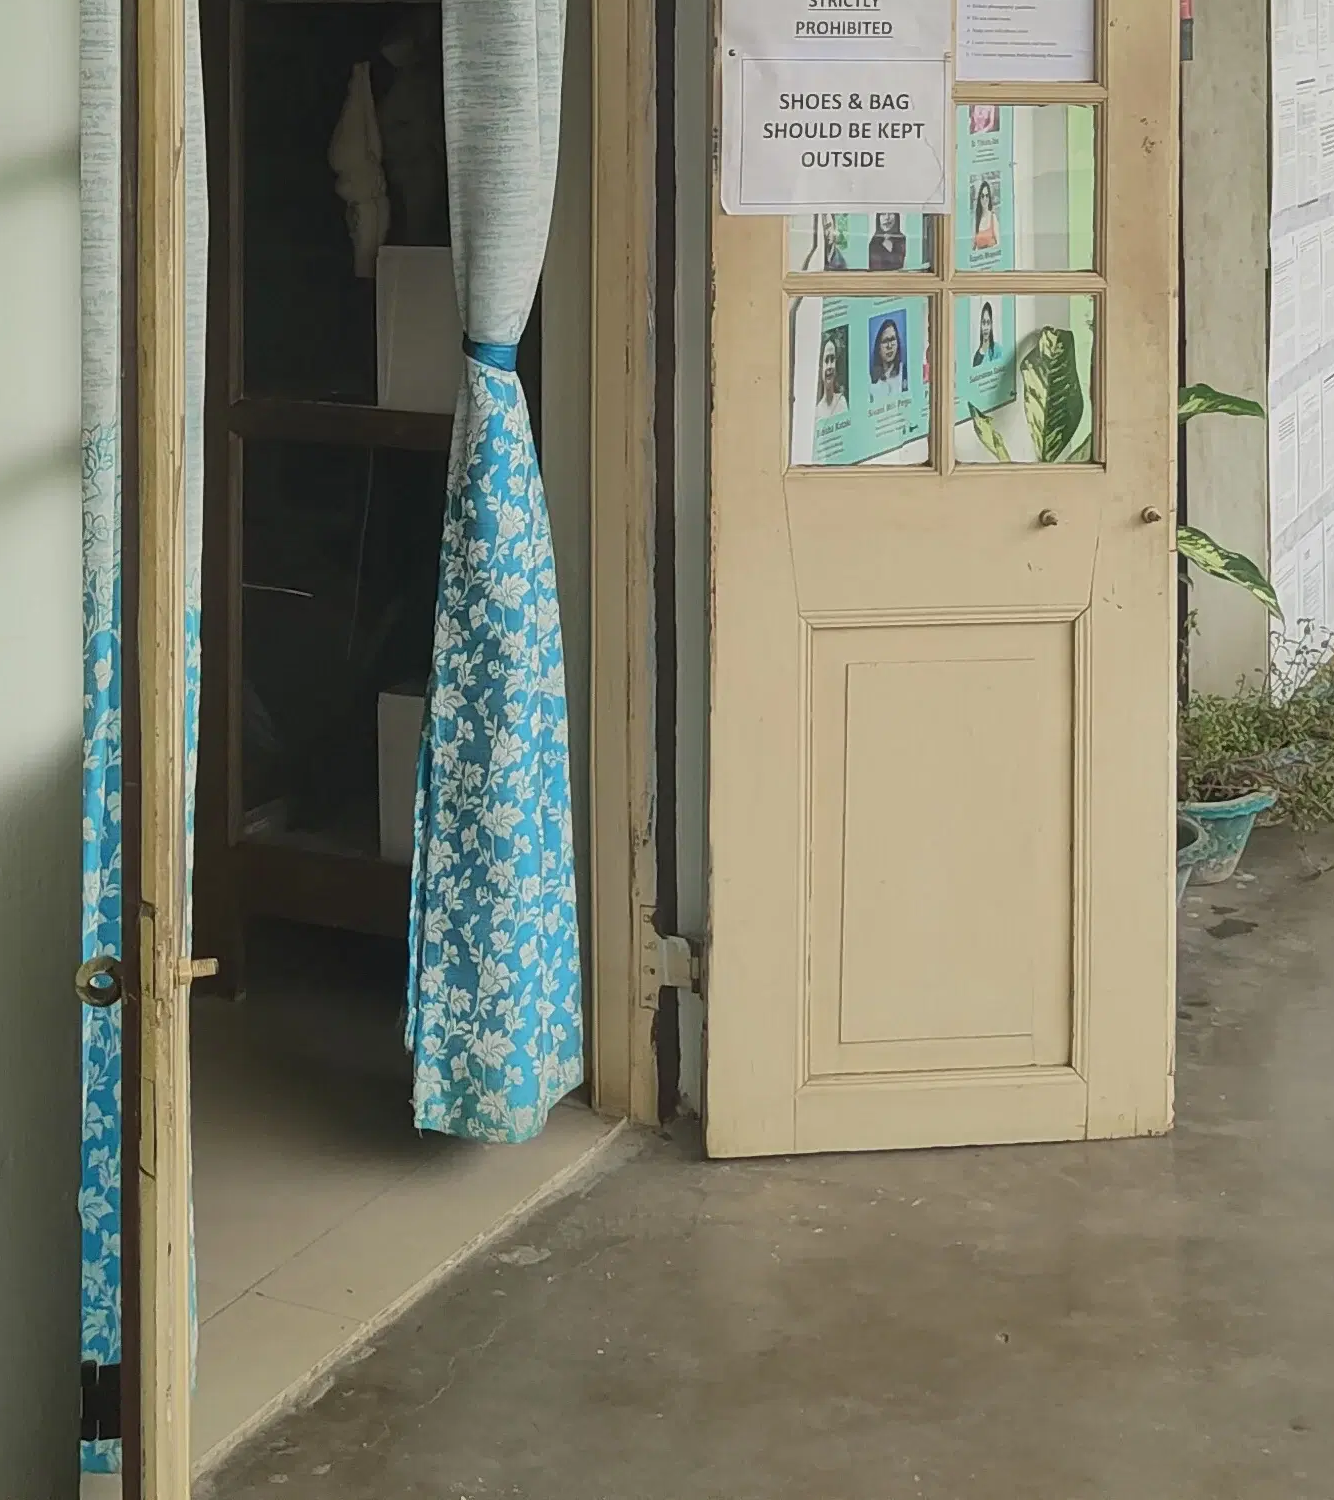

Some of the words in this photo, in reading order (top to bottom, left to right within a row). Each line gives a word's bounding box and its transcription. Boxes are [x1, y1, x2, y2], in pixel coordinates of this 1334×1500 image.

[795, 20, 893, 36] PROHIBITED
[780, 93, 842, 110] SHOES
[848, 93, 864, 110] &
[869, 94, 910, 110] BAG
[763, 123, 841, 140] SHOULD
[848, 123, 873, 139] BE
[878, 122, 925, 140] KEPT
[802, 151, 886, 168] OUTSIDE
